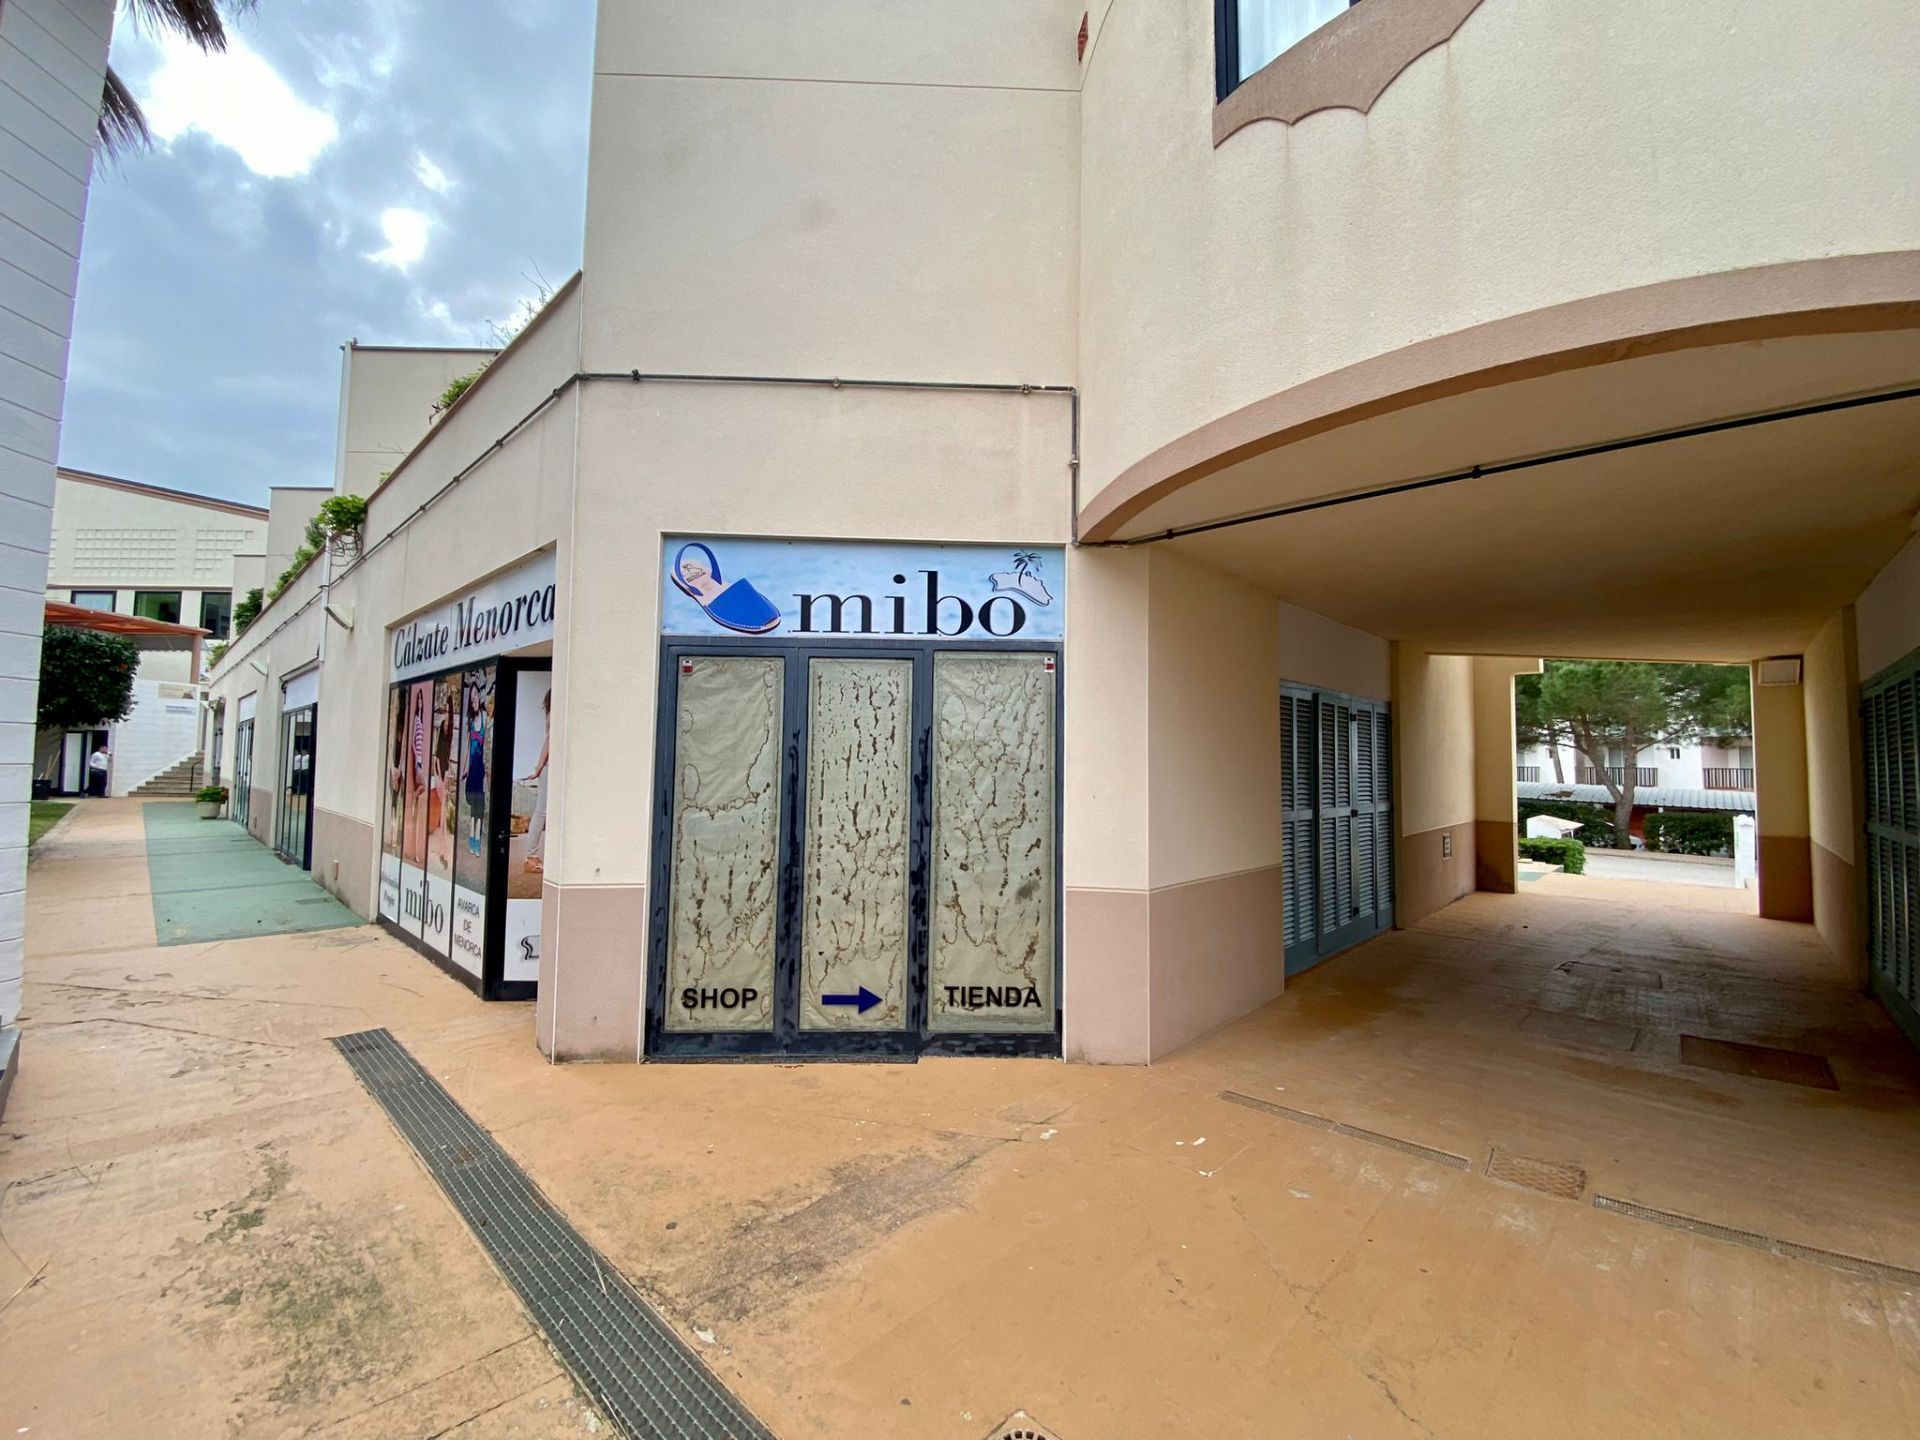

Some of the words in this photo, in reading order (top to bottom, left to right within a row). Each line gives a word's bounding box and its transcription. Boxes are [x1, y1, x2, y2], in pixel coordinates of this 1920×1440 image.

[791, 570, 1026, 636] mibo
[394, 622, 449, 669] Cálzate
[453, 583, 556, 651] Menorca
[405, 880, 444, 934] mibo
[457, 897, 481, 917] AVARCA
[463, 919, 472, 933] DE
[454, 933, 482, 959] MENORCA
[681, 987, 758, 1009] SHOP
[944, 985, 1042, 1008] TIENDA
